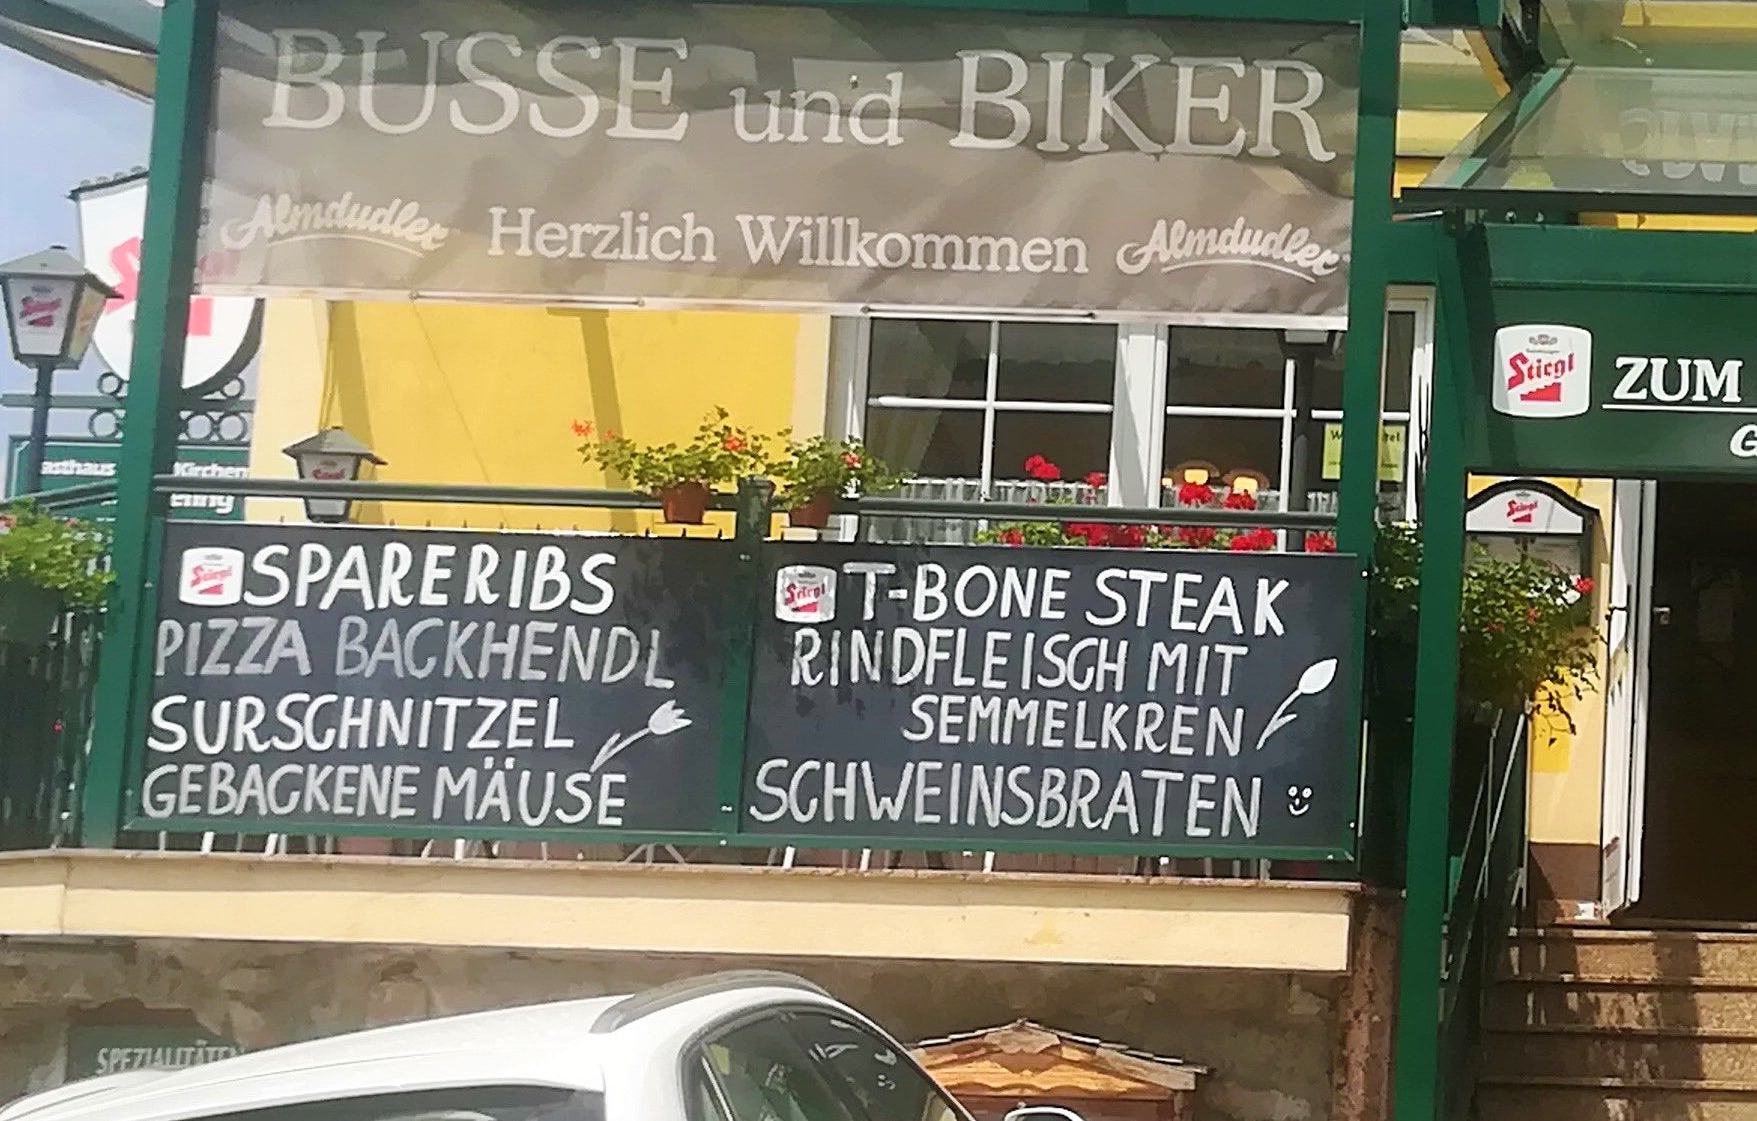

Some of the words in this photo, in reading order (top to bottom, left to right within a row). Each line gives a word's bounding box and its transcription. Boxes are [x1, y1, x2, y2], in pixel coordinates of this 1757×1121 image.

[262, 28, 689, 142] BUSSE
[730, 73, 904, 146] und
[950, 49, 1336, 162] BIKER
[221, 192, 448, 252] Almdudler
[487, 207, 717, 263] Herzlich
[735, 215, 1089, 275] Willkommen
[1115, 217, 1342, 277] Almdudler
[1507, 352, 1575, 391] Stiegl
[1613, 356, 1744, 403] ZUM
[41, 459, 117, 477] asthaus
[243, 542, 617, 616] SPARERIBS
[842, 562, 1068, 623] T-BONE
[1085, 568, 1289, 637] STEAK
[155, 616, 312, 677] PIZZA
[335, 615, 675, 690] BACKHENDL
[790, 626, 1130, 693] RINDFLEISCH
[1146, 642, 1249, 697] MIT
[147, 692, 575, 755] SURSCHNITZEL
[902, 694, 1245, 758] SEMMELKREN
[141, 763, 420, 818] GEBACKENE
[431, 755, 628, 827] MÄUSE
[749, 758, 1262, 838] SCHWEINSBRATEN
